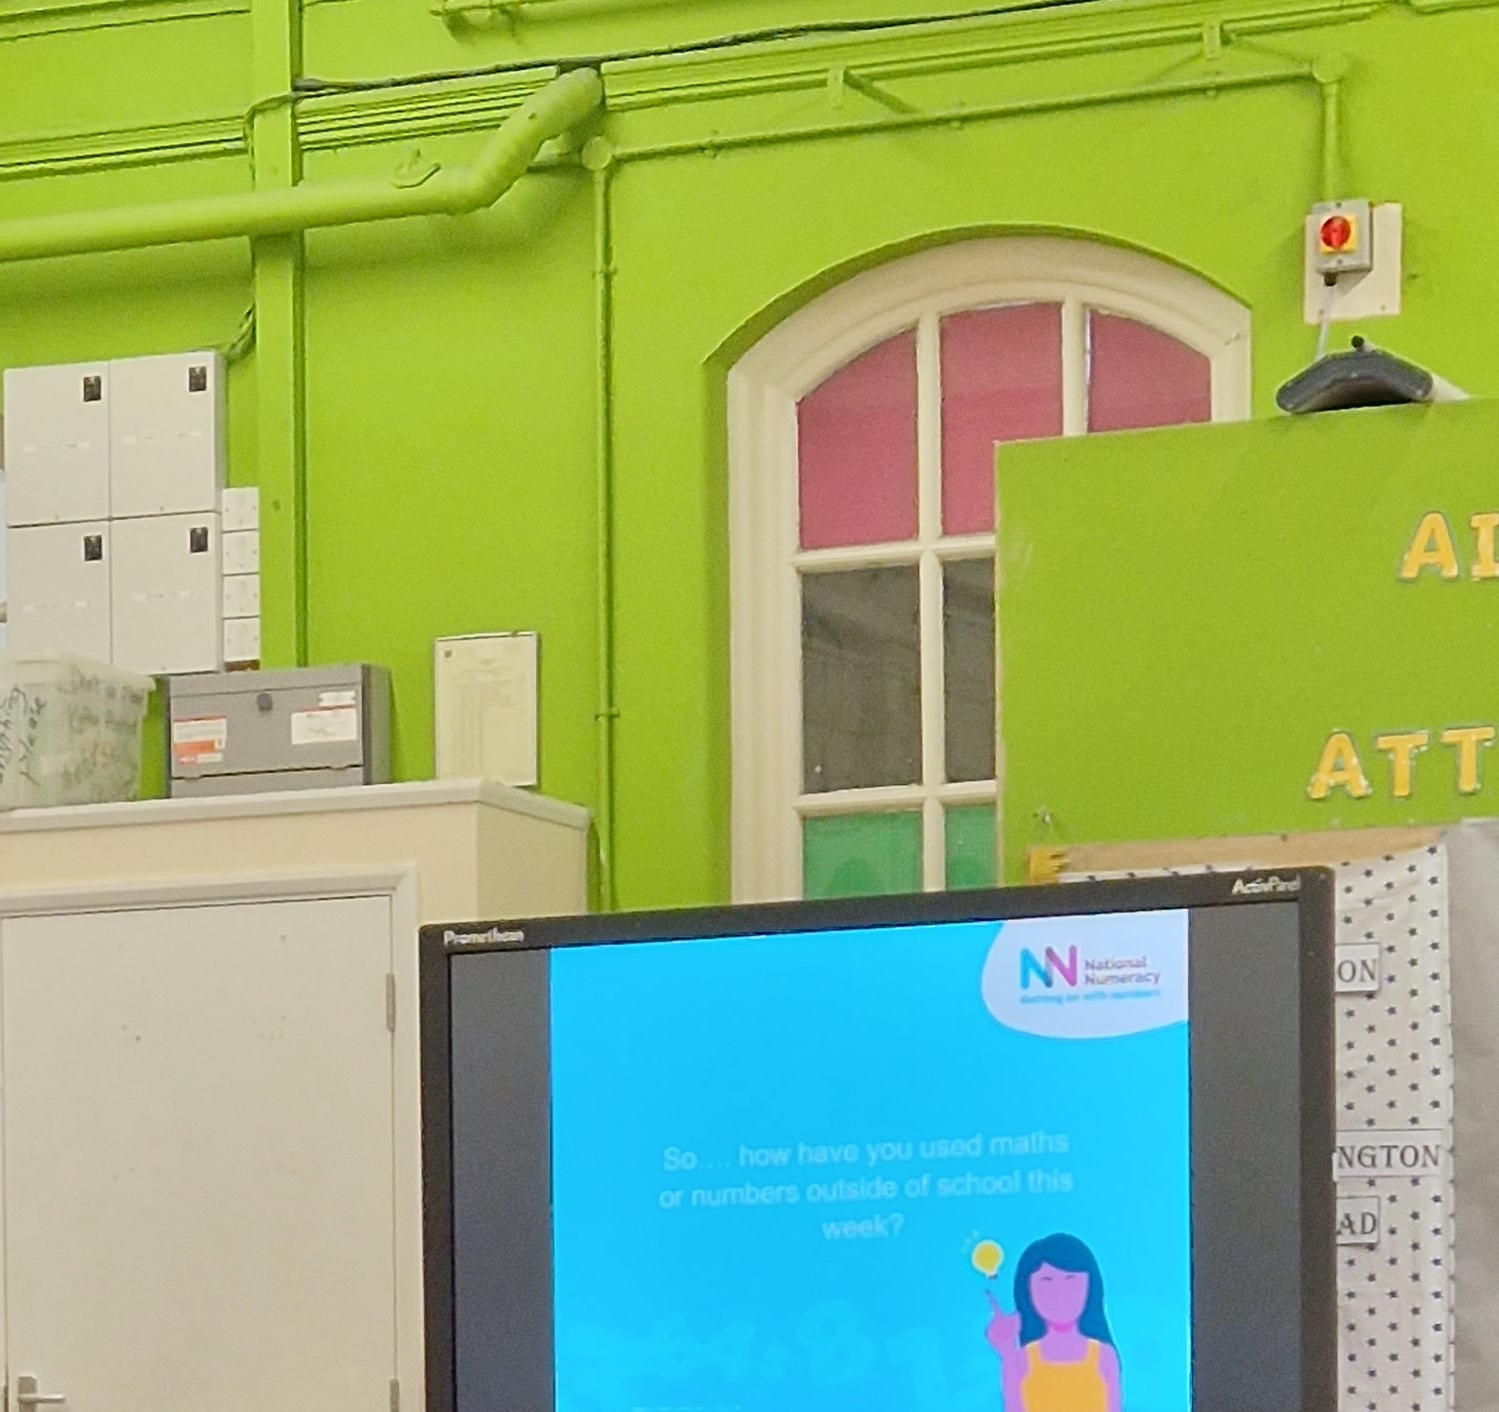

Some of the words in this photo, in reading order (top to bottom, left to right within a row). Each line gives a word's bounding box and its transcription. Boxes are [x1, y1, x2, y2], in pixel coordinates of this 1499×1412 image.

[1306, 724, 1497, 800] ATT
[1083, 954, 1148, 972] National
[1337, 959, 1378, 983] ON
[1083, 971, 1162, 987] Numeracy
[738, 1144, 792, 1168] how
[797, 1141, 861, 1166] have
[866, 1141, 914, 1168] you
[920, 1132, 983, 1159] used
[988, 1129, 1070, 1157] maths
[658, 1188, 685, 1210] or
[691, 1182, 800, 1207] numbers
[805, 1174, 899, 1203] outside
[903, 1172, 932, 1199] of
[936, 1168, 1022, 1198] school
[1026, 1167, 1076, 1194] this
[821, 1211, 906, 1240] week?
[1336, 1211, 1377, 1236] AD
